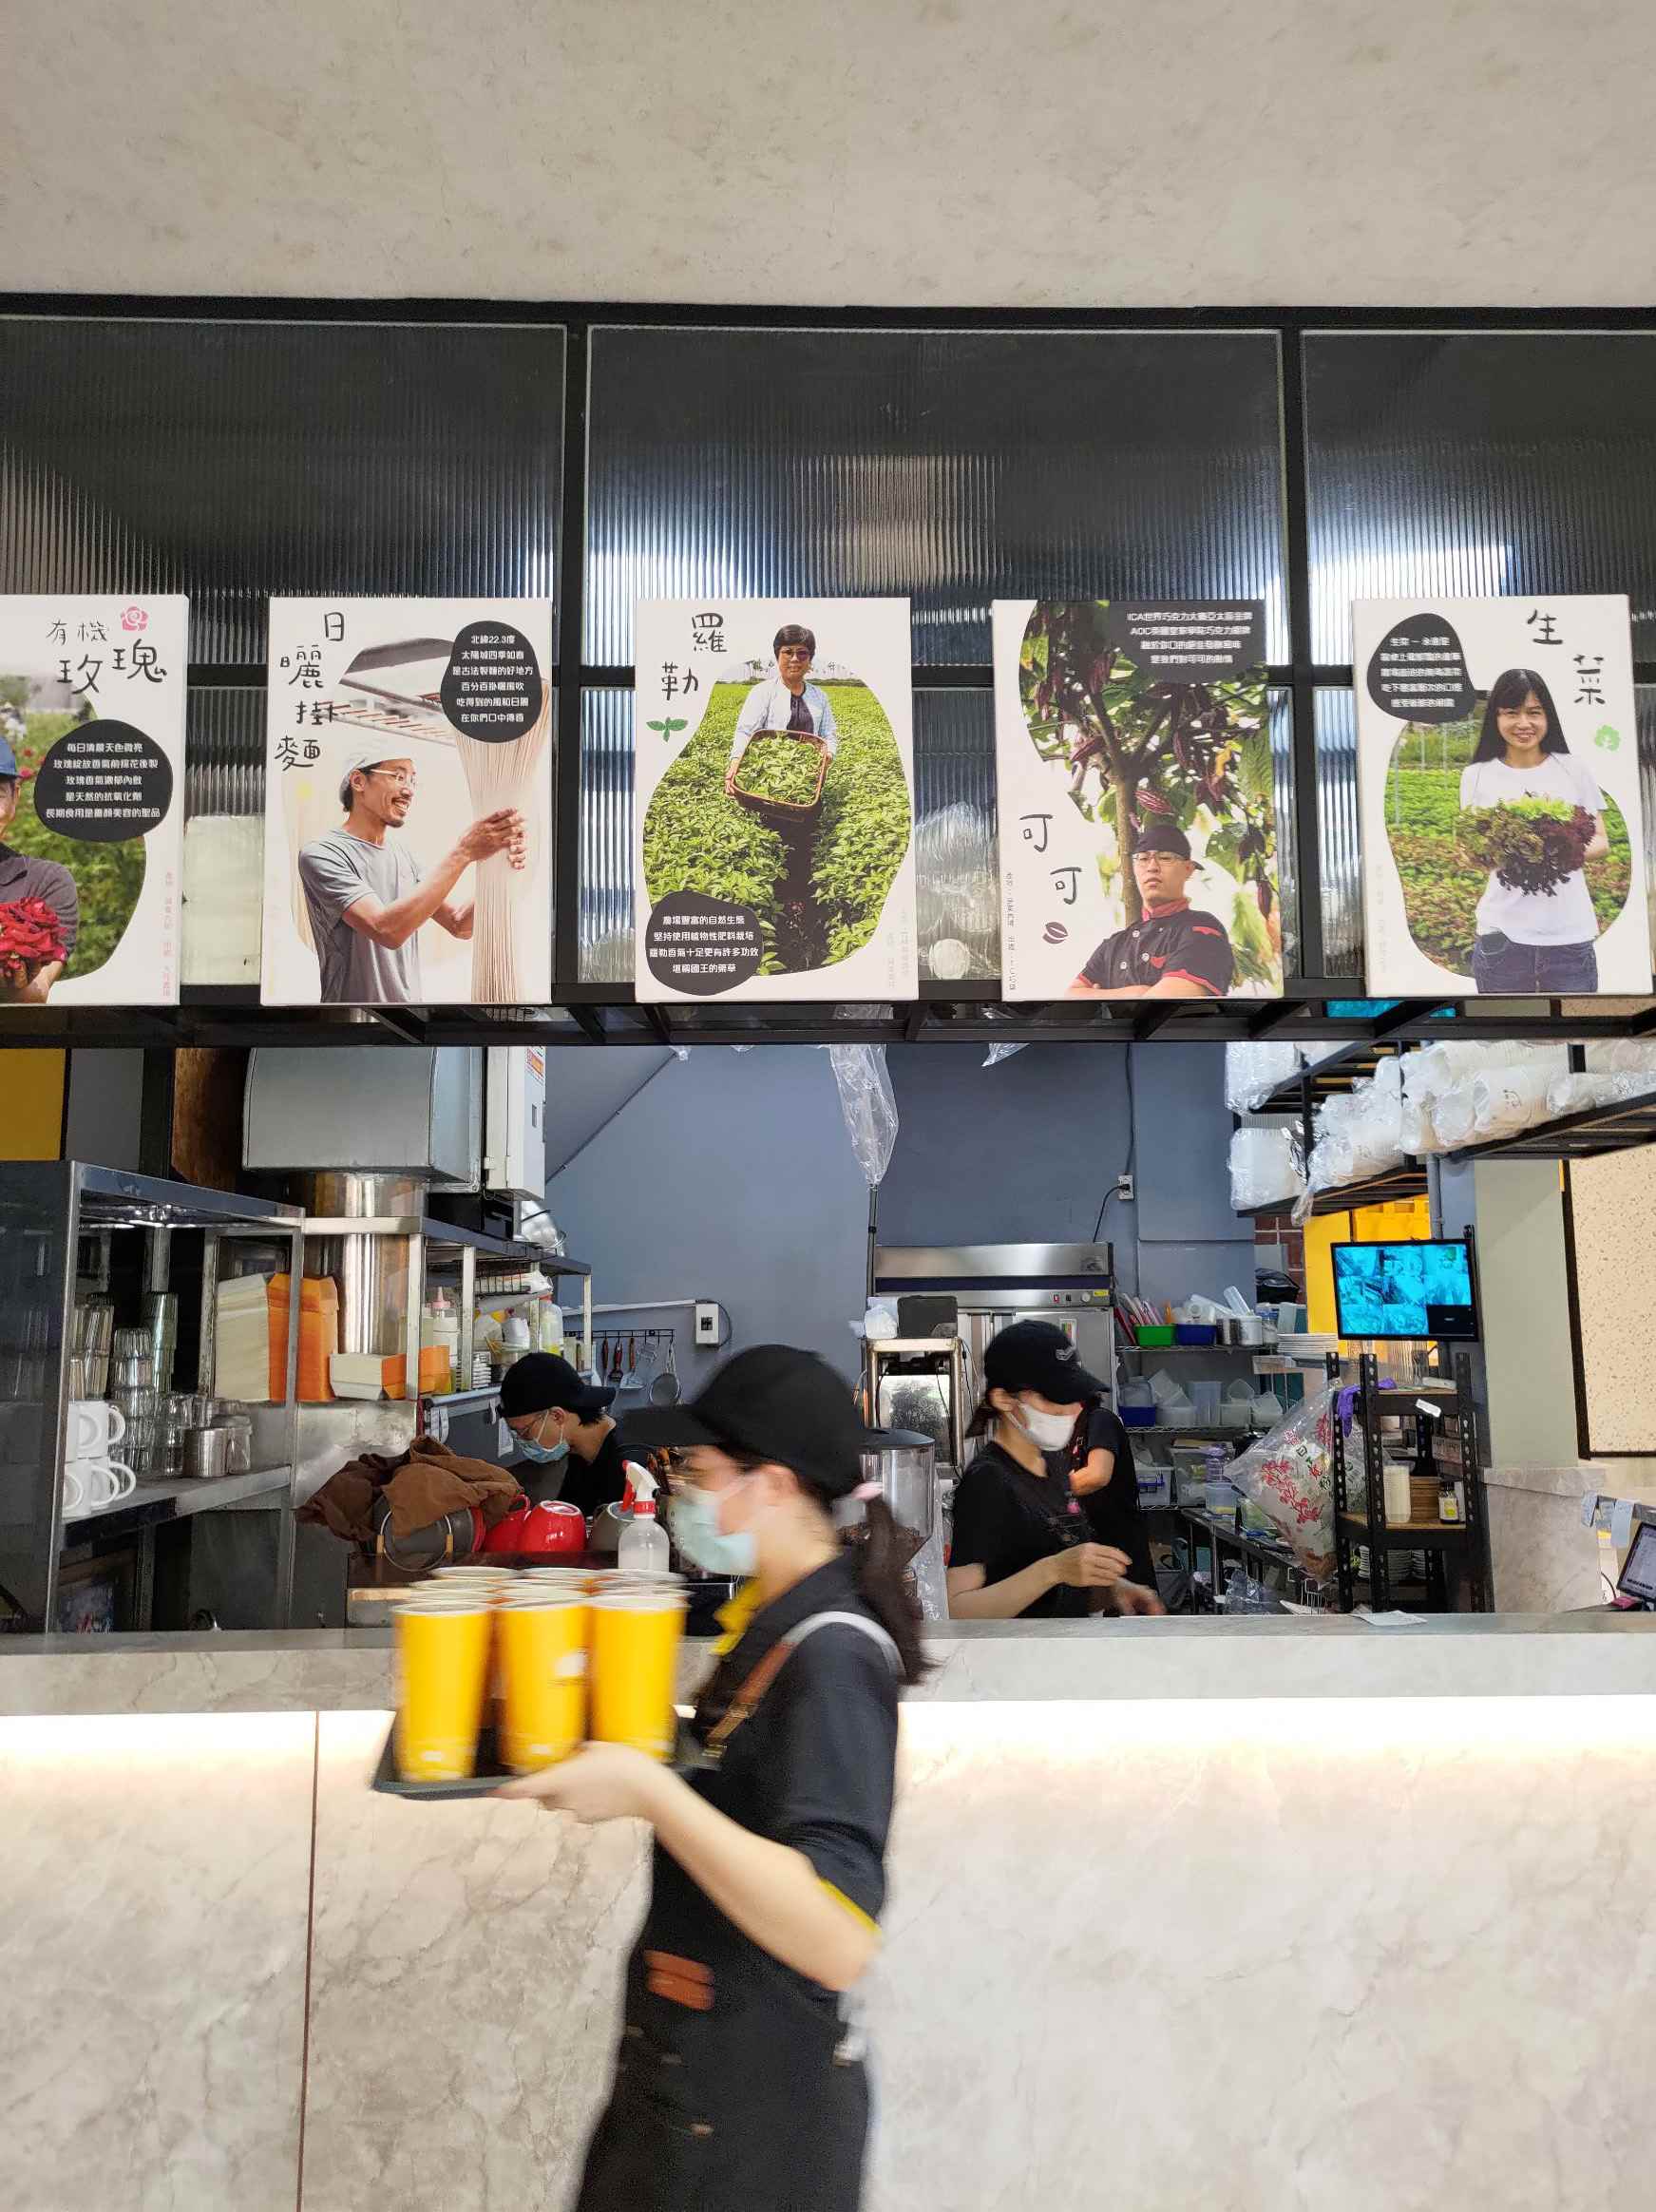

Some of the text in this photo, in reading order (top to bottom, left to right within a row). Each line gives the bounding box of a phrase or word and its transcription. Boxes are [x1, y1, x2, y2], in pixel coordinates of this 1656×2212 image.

[46, 620, 107, 645] 有機
[57, 639, 167, 695] 玫瑰
[661, 612, 728, 701] 羅勒
[1527, 609, 1606, 706] 生菜
[1019, 812, 1081, 905] 可可
